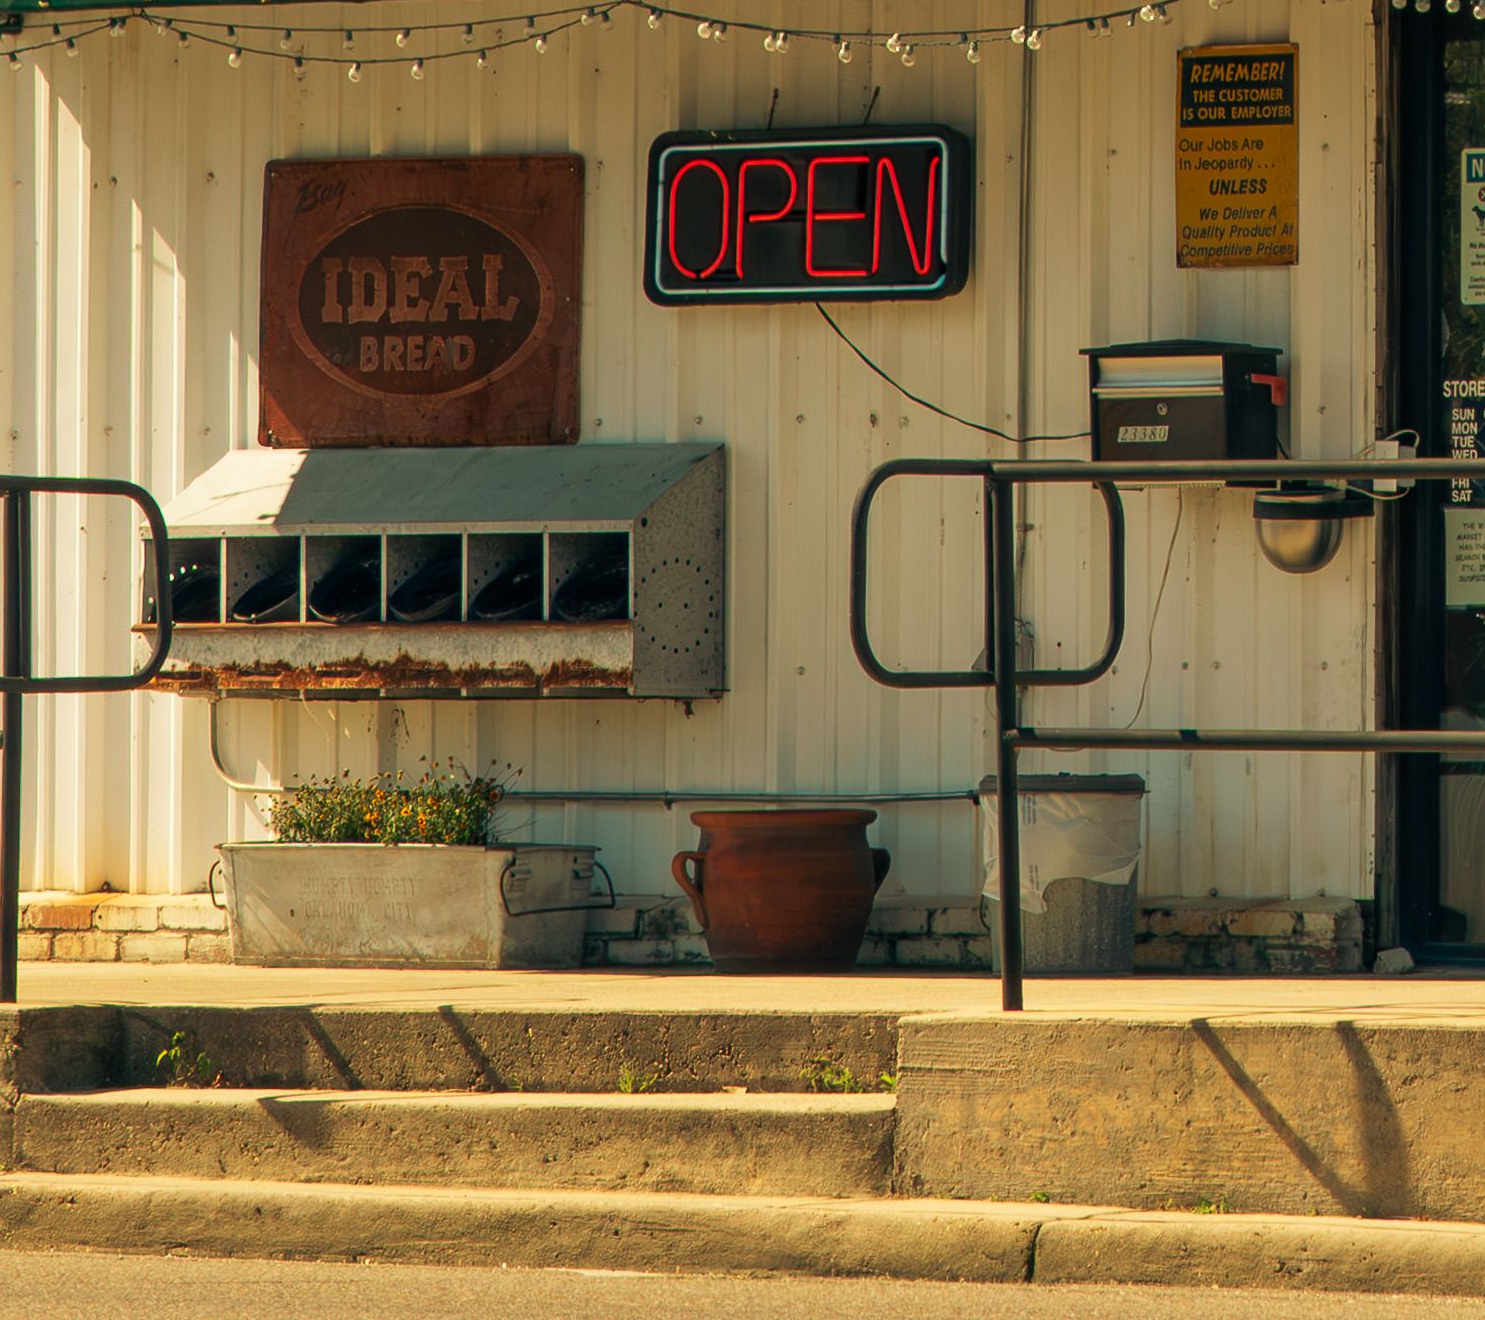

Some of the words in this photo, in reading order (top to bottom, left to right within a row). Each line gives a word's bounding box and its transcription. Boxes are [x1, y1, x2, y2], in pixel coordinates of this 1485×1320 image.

[1190, 61, 1285, 83] REMEMBER!
[1192, 89, 1216, 103] THE
[1219, 87, 1283, 102] CUSTOMER
[1182, 108, 1194, 120] IS
[1197, 106, 1226, 119] OUR
[1231, 105, 1292, 119] EMPLOYER
[1179, 138, 1204, 152] Our
[1207, 137, 1238, 152] Jobs
[1241, 137, 1264, 151] Are
[1179, 157, 1192, 170] In
[1209, 178, 1268, 196] UNLESS
[669, 156, 940, 280] OPEN
[1199, 208, 1219, 221] We
[1222, 206, 1265, 220] Deliver
[1268, 205, 1278, 219] A
[1182, 224, 1225, 241] Quality
[1229, 223, 1277, 238] Product
[1281, 222, 1293, 237] At
[1180, 243, 1253, 258] Competitive
[1256, 241, 1293, 255] Prices
[320, 252, 520, 324] IDEAL
[359, 334, 477, 373] BREAD
[1443, 380, 1485, 397] STORE
[1452, 408, 1475, 421] SUN
[1120, 427, 1166, 441] 23380
[1451, 422, 1478, 435] MON
[1452, 436, 1475, 448] TUE
[1452, 449, 1478, 459] WED
[1452, 478, 1470, 489] FRI
[1452, 490, 1473, 503] SAT
